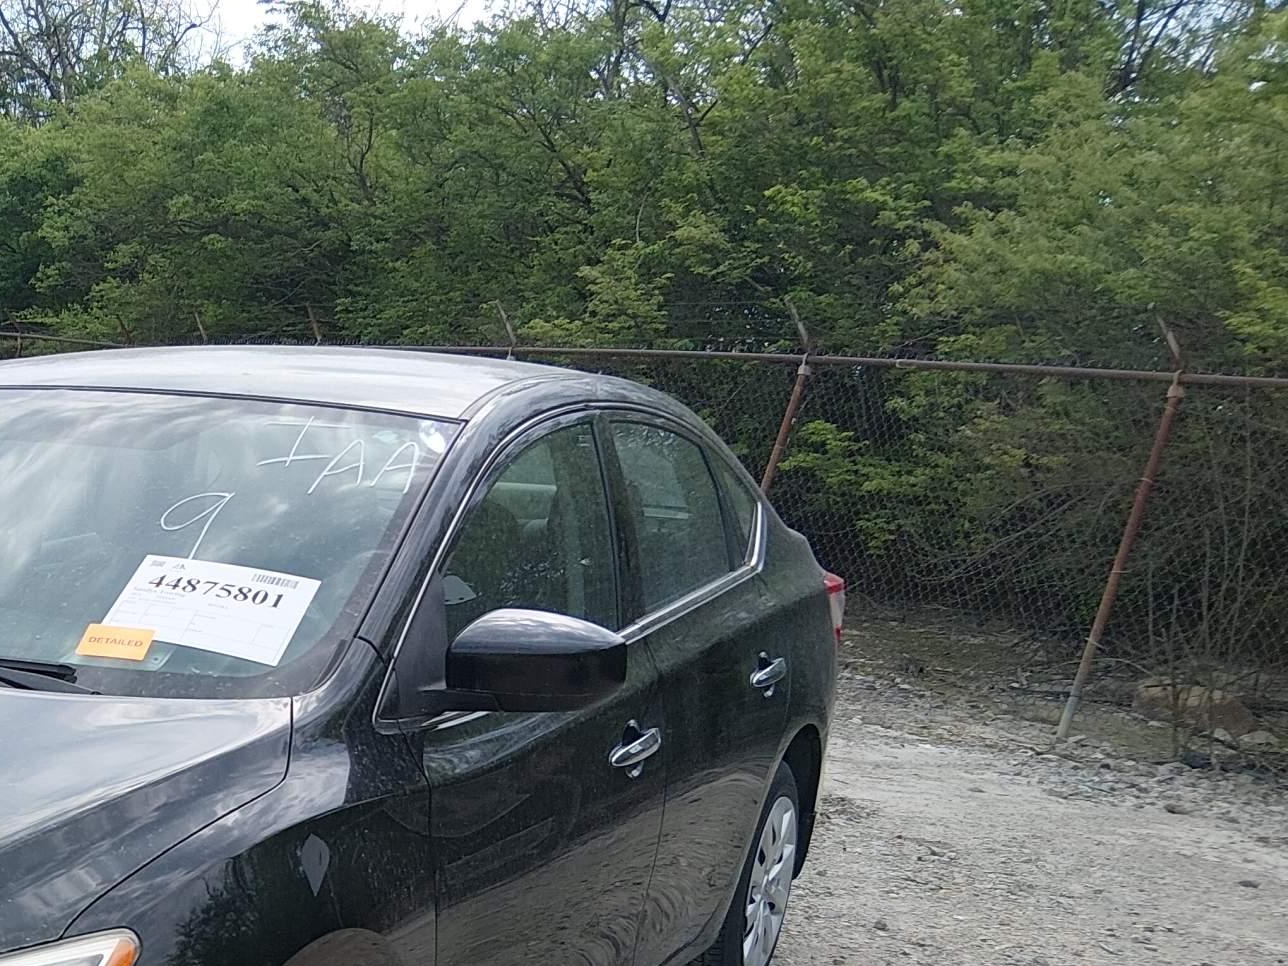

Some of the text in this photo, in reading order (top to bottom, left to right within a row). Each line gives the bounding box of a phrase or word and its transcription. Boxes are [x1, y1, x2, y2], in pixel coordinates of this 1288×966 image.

[256, 415, 421, 495] IAA
[148, 573, 285, 609] 44875801
[88, 636, 144, 648] DETAILED
